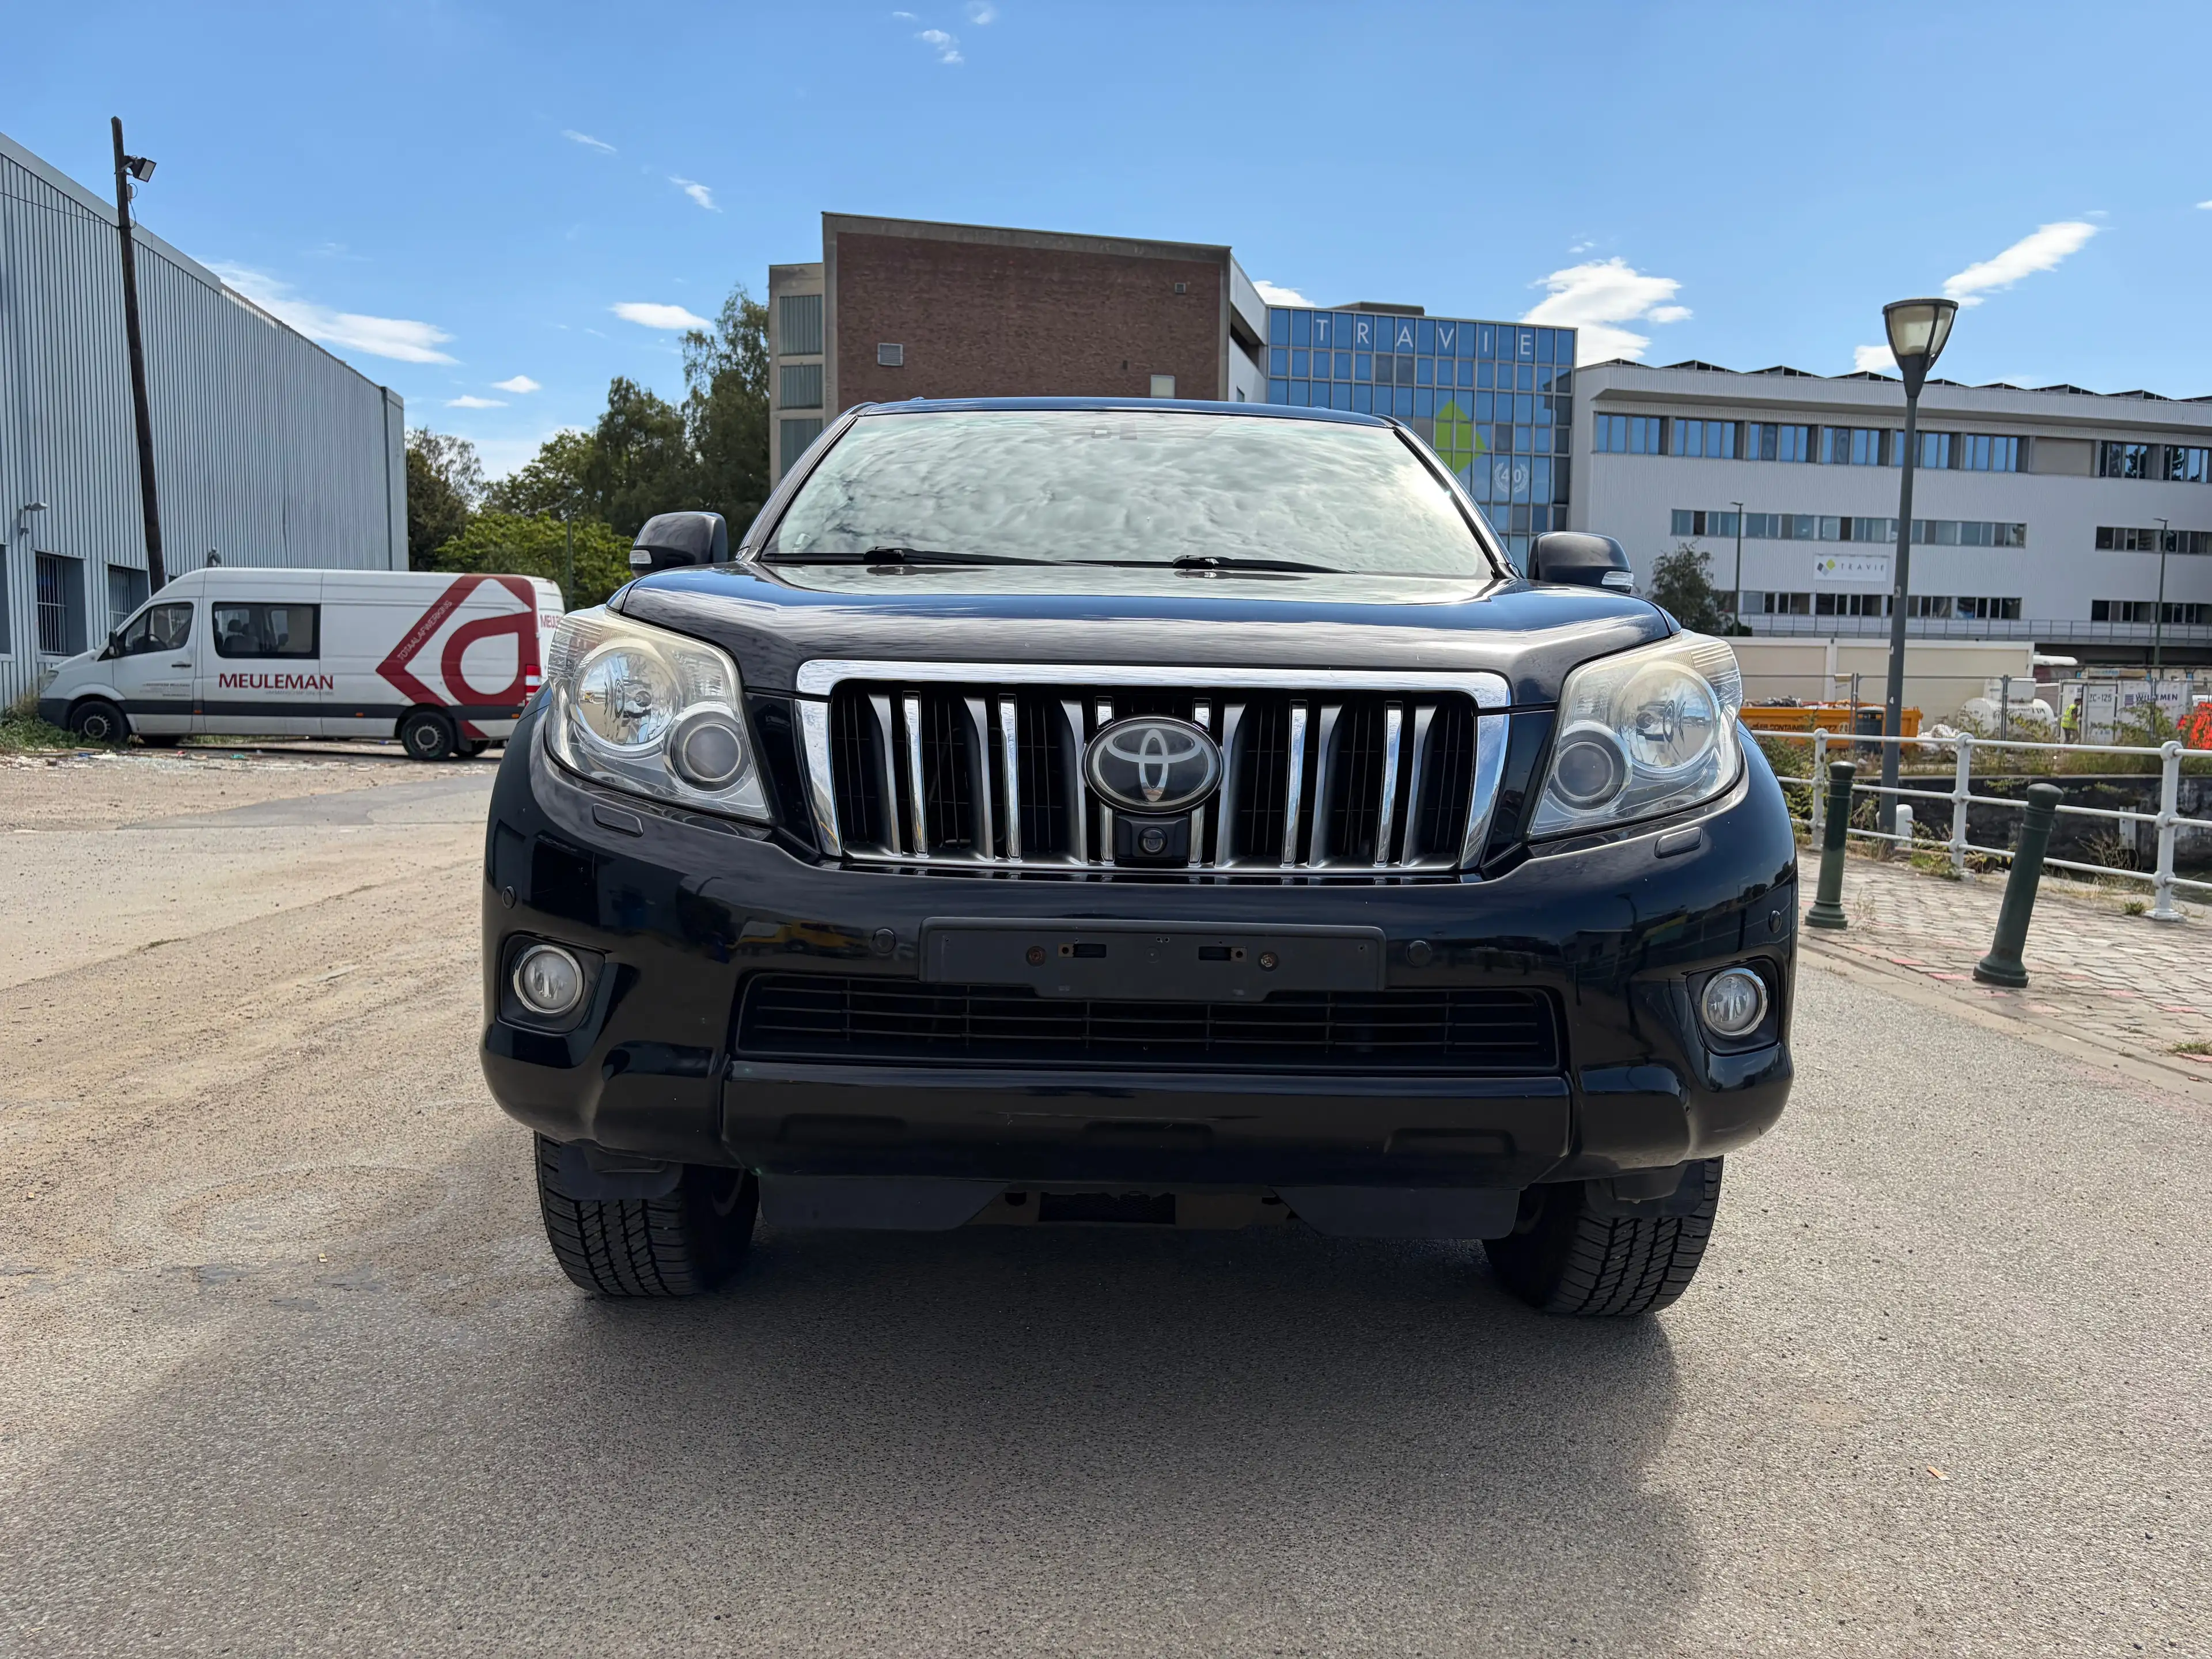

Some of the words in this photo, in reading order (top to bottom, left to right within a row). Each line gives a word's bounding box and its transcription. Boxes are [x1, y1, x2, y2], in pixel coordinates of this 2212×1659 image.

[1316, 319, 1532, 355] TRAVIE
[1501, 468, 1522, 483] 40
[219, 673, 334, 690] MEULEMAN
